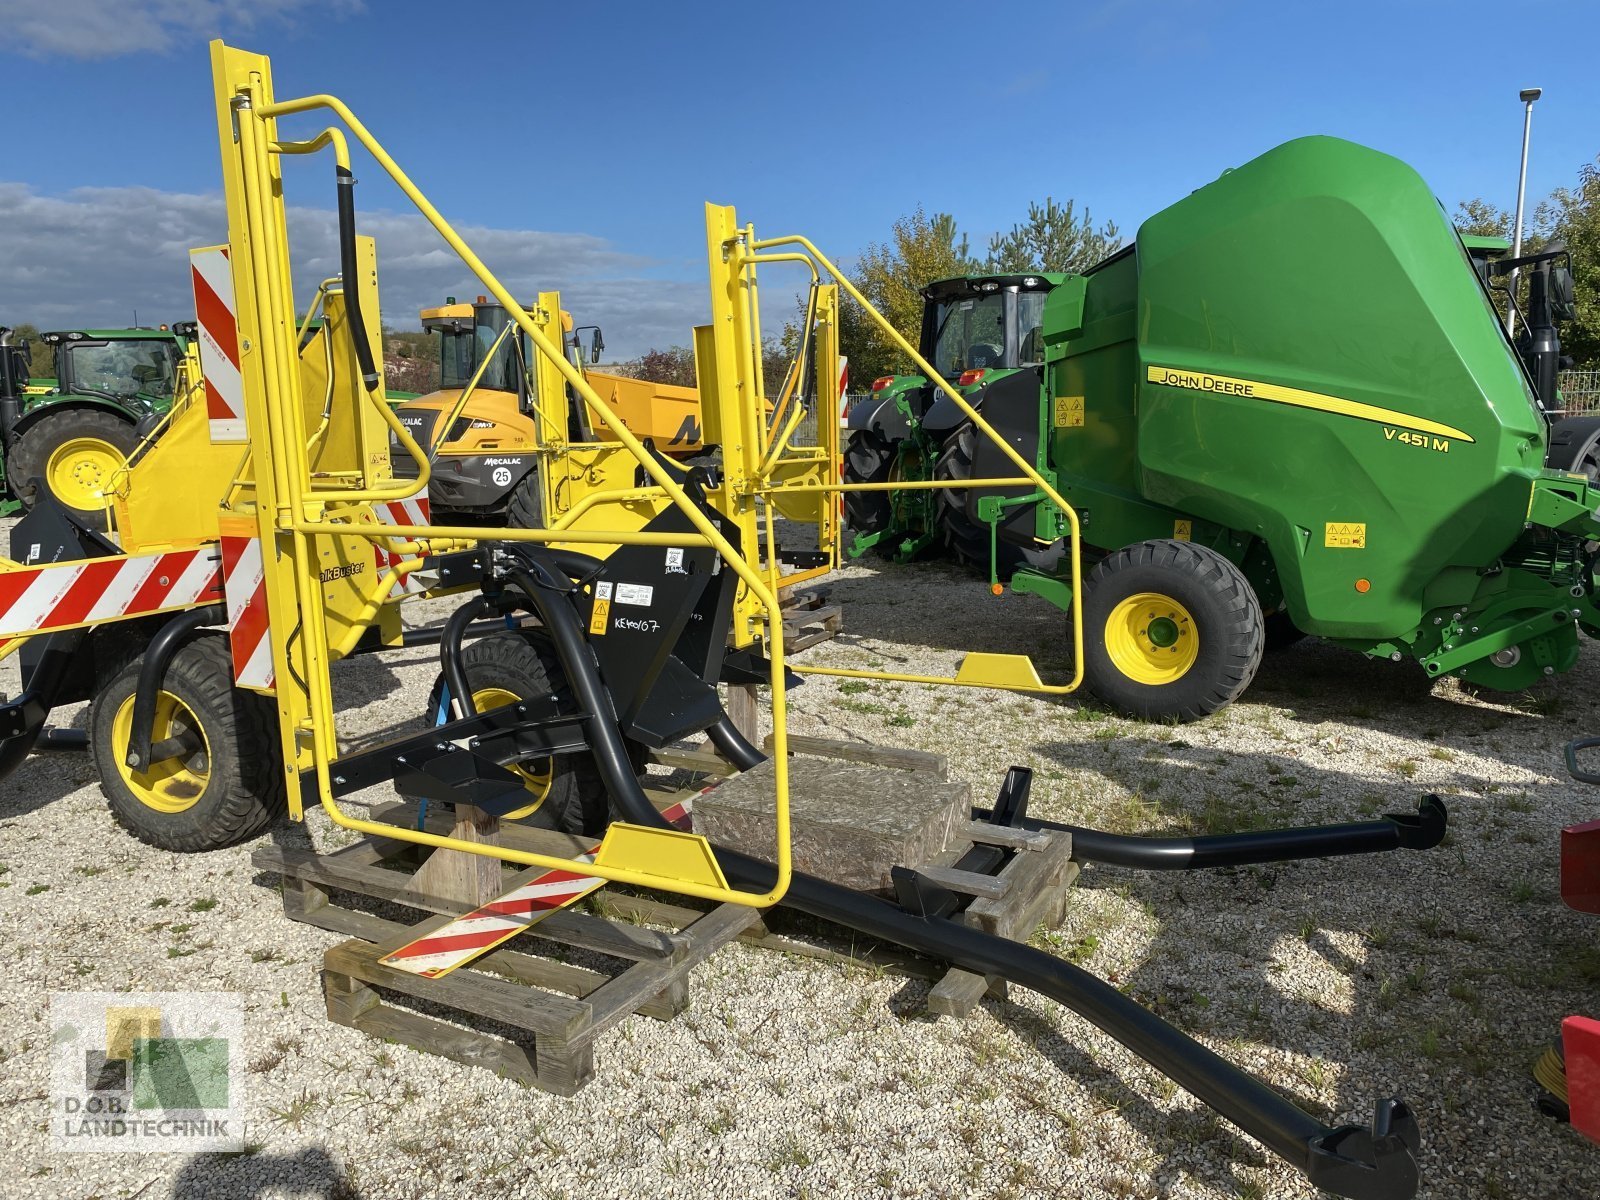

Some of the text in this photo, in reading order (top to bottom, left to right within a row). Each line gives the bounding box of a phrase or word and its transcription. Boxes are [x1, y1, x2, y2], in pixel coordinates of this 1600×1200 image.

[1160, 371, 1254, 396] JOHN DEERE
[1383, 427, 1450, 453] V 451 M
[495, 471, 509, 482] 25
